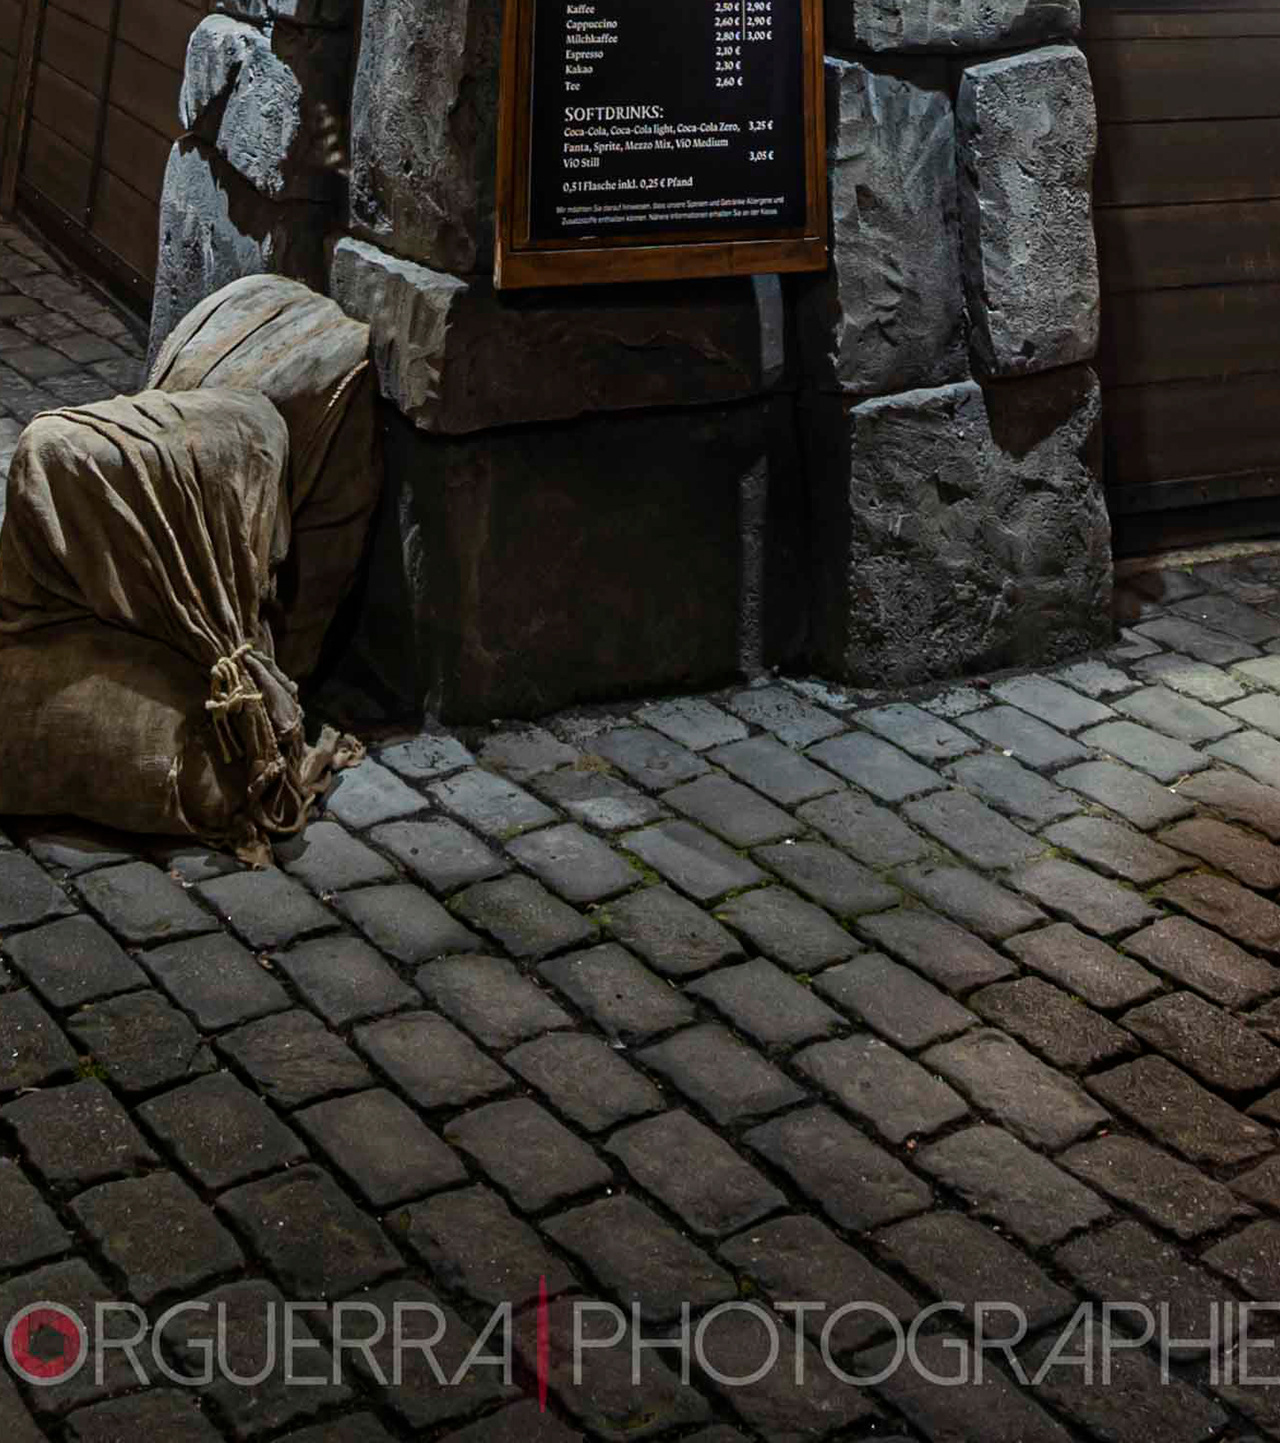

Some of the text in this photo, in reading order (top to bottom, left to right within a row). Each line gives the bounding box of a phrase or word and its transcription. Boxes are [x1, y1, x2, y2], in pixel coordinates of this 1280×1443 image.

[567, 5, 595, 14] Kaffee
[747, 2, 765, 11] 2,90
[566, 20, 617, 31] Cappuccino
[747, 17, 765, 26] 2,90
[566, 35, 618, 44] Milchkaffee
[747, 31, 765, 40] 3,00
[566, 50, 603, 61] Espresso
[566, 65, 593, 74] Kakao
[565, 82, 580, 91] Tee
[565, 105, 664, 121] SOFTDRINKS:
[564, 122, 741, 137] Coca-Cola, Coca-Cola light, Coca-Cola Zero,
[564, 142, 592, 153] Fanta,
[594, 142, 623, 153] Sprite,
[625, 140, 653, 150] Mezzo
[655, 140, 674, 150] Mix,
[693, 138, 728, 147] Medium
[581, 157, 599, 167] Still
[563, 182, 577, 192] 0,5
[584, 181, 616, 191] Flasche
[618, 179, 638, 190] inkl.
[640, 179, 658, 189] 0,25
[668, 177, 693, 187] Pfand
